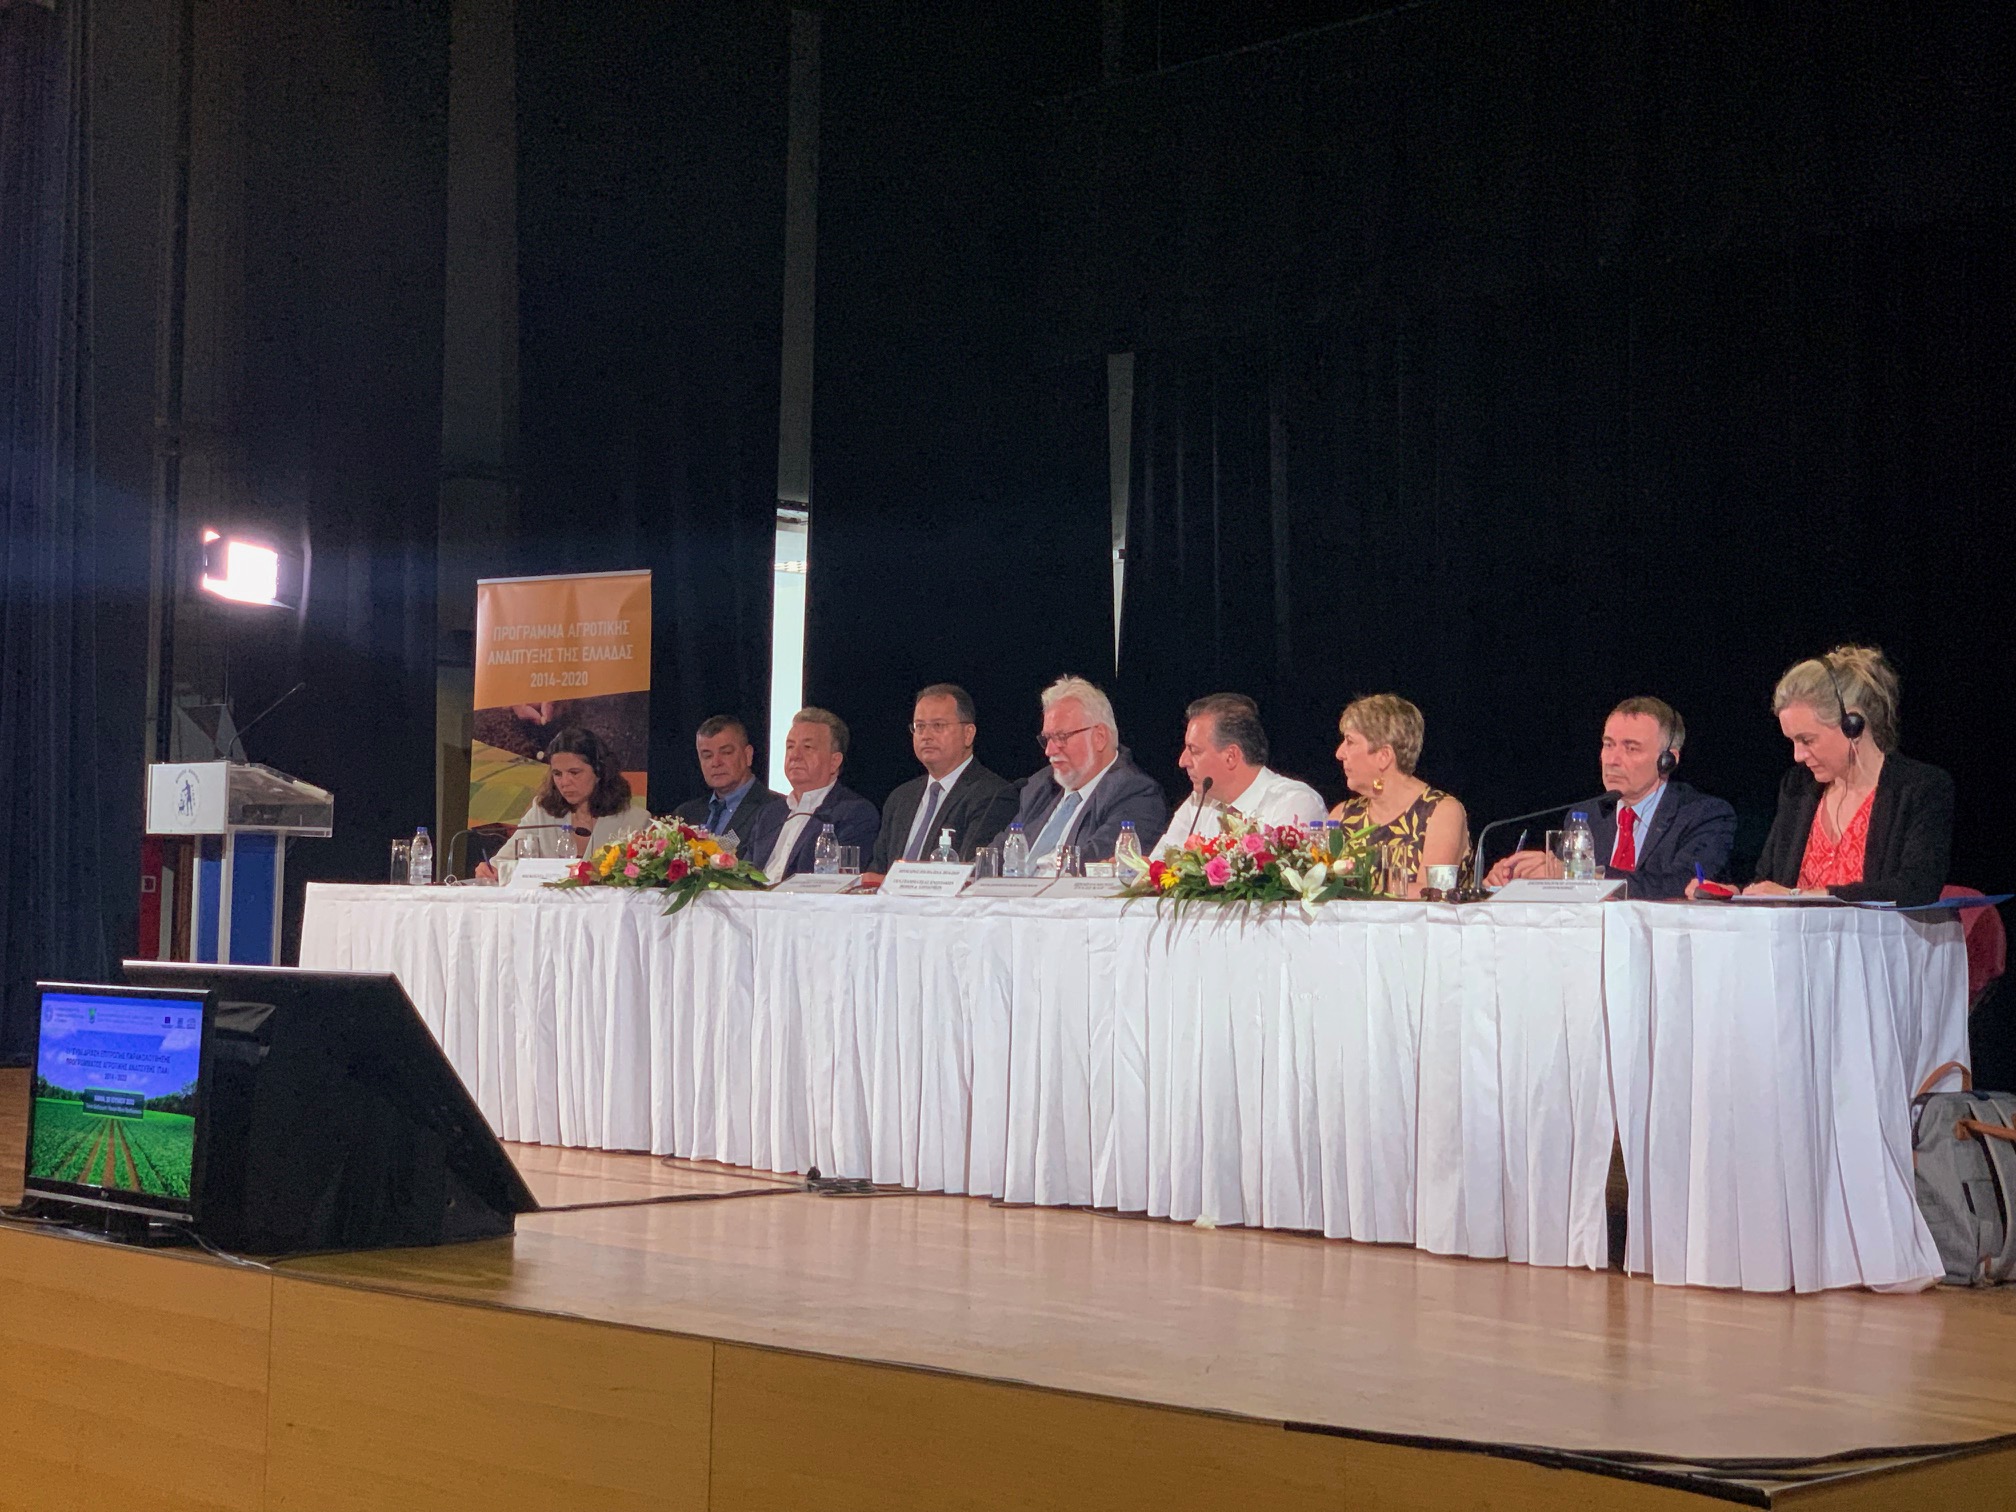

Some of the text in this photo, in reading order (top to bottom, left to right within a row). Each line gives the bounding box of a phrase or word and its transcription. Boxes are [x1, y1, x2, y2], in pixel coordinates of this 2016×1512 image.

[493, 620, 630, 641] ΠΡΟΓΡΑΜΜΑ ΑΓΡΟΤΙΚΗΣ
[488, 645, 633, 665] ΑΝΑΠΤΥΞΗΣ ΤΗΣ ΕΛΛΑΔΑΣ
[530, 671, 589, 688] 2014-2020
